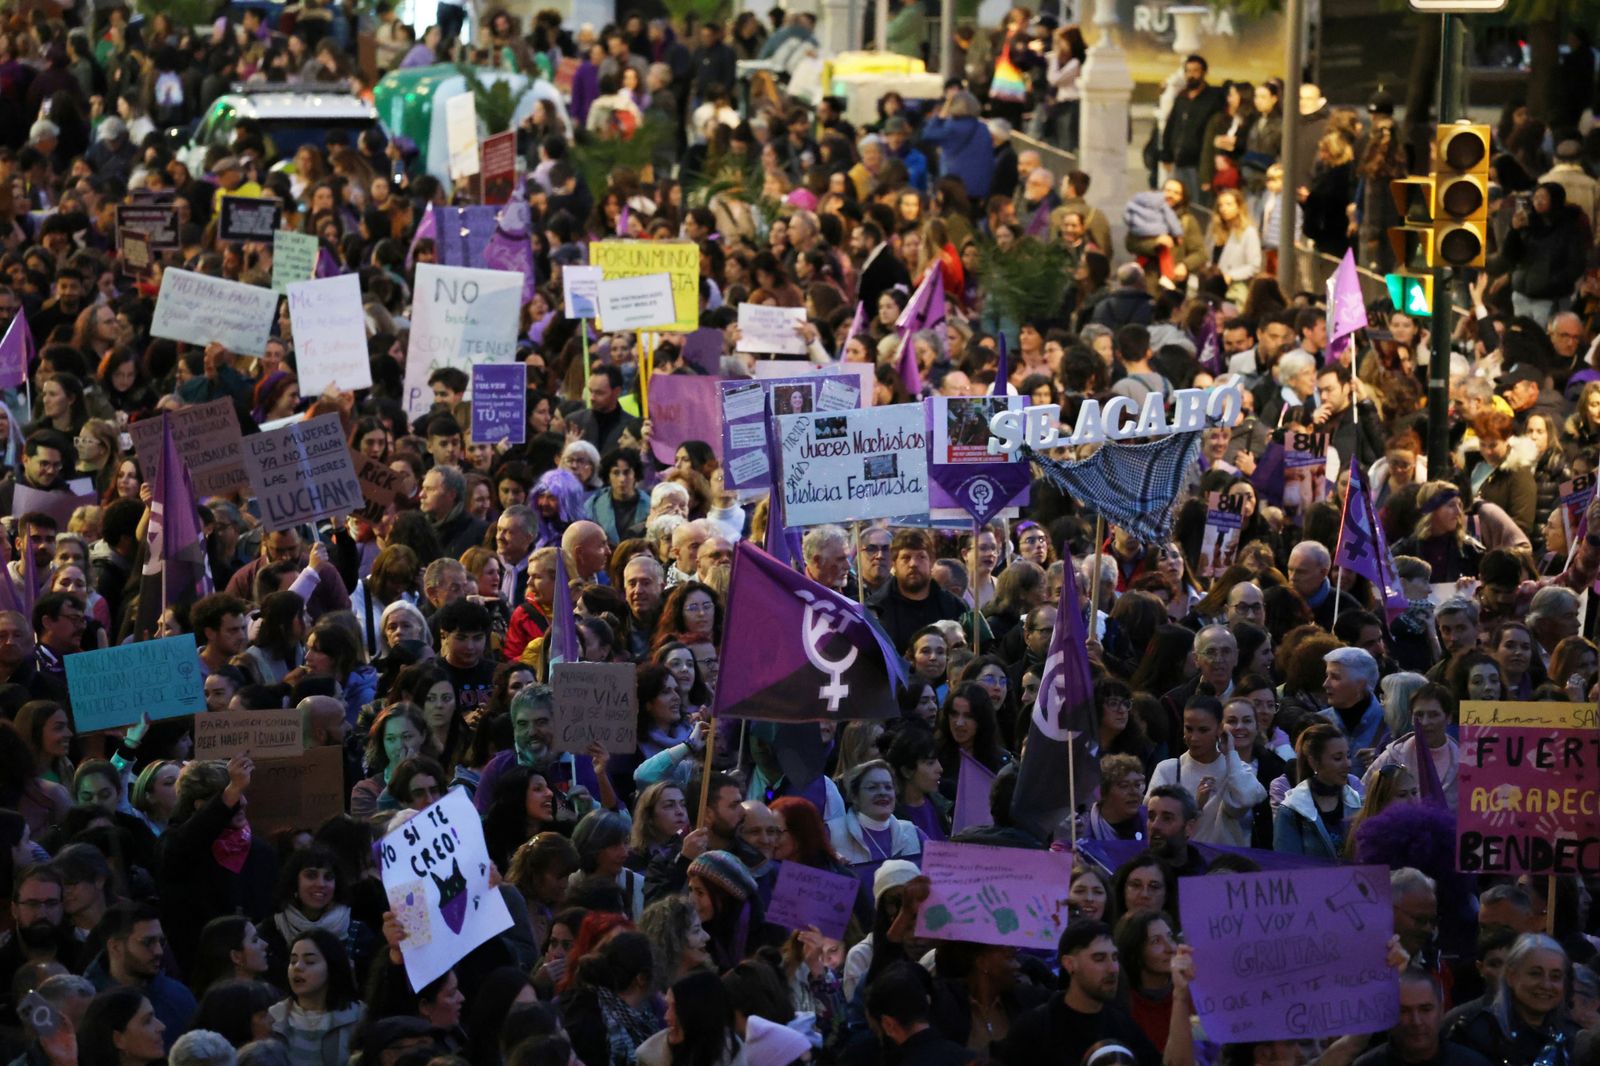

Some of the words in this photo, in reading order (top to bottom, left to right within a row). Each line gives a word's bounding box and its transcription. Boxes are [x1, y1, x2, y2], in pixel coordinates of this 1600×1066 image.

[596, 247, 629, 266] POR
[630, 249, 650, 268] UN
[651, 248, 698, 269] MUNDO
[433, 277, 480, 304] NO
[133, 419, 176, 440] TODS
[250, 439, 275, 456] LAS
[282, 421, 339, 447] MUJERES
[799, 432, 851, 460] Jueces
[852, 426, 926, 455] Machistas
[986, 402, 1061, 456] SE
[258, 456, 280, 470] YA
[282, 451, 302, 465] NO
[304, 438, 343, 456] CALLAN
[1293, 432, 1326, 458] 8M
[262, 473, 282, 488] LAS
[295, 458, 348, 480] MUJERES
[267, 477, 349, 524] LUCHAN
[785, 479, 843, 505] Justicia
[1217, 494, 1245, 514] 8M
[593, 687, 631, 707] VIVA
[200, 719, 231, 731] PARA
[1463, 709, 1483, 725] En
[1491, 708, 1553, 725] honor
[220, 731, 250, 747] HABER
[253, 730, 297, 745] IGUALDAD
[381, 842, 397, 869] YO
[427, 804, 449, 828] TE
[410, 826, 461, 878] CREO!
[1207, 911, 1245, 941] HOY
[1254, 911, 1296, 935] VOY
[1304, 910, 1319, 931] A
[1233, 931, 1342, 978] GRITAR
[1222, 991, 1253, 1012] QUE
[1261, 989, 1273, 1006] A
[1303, 974, 1327, 992] TE
